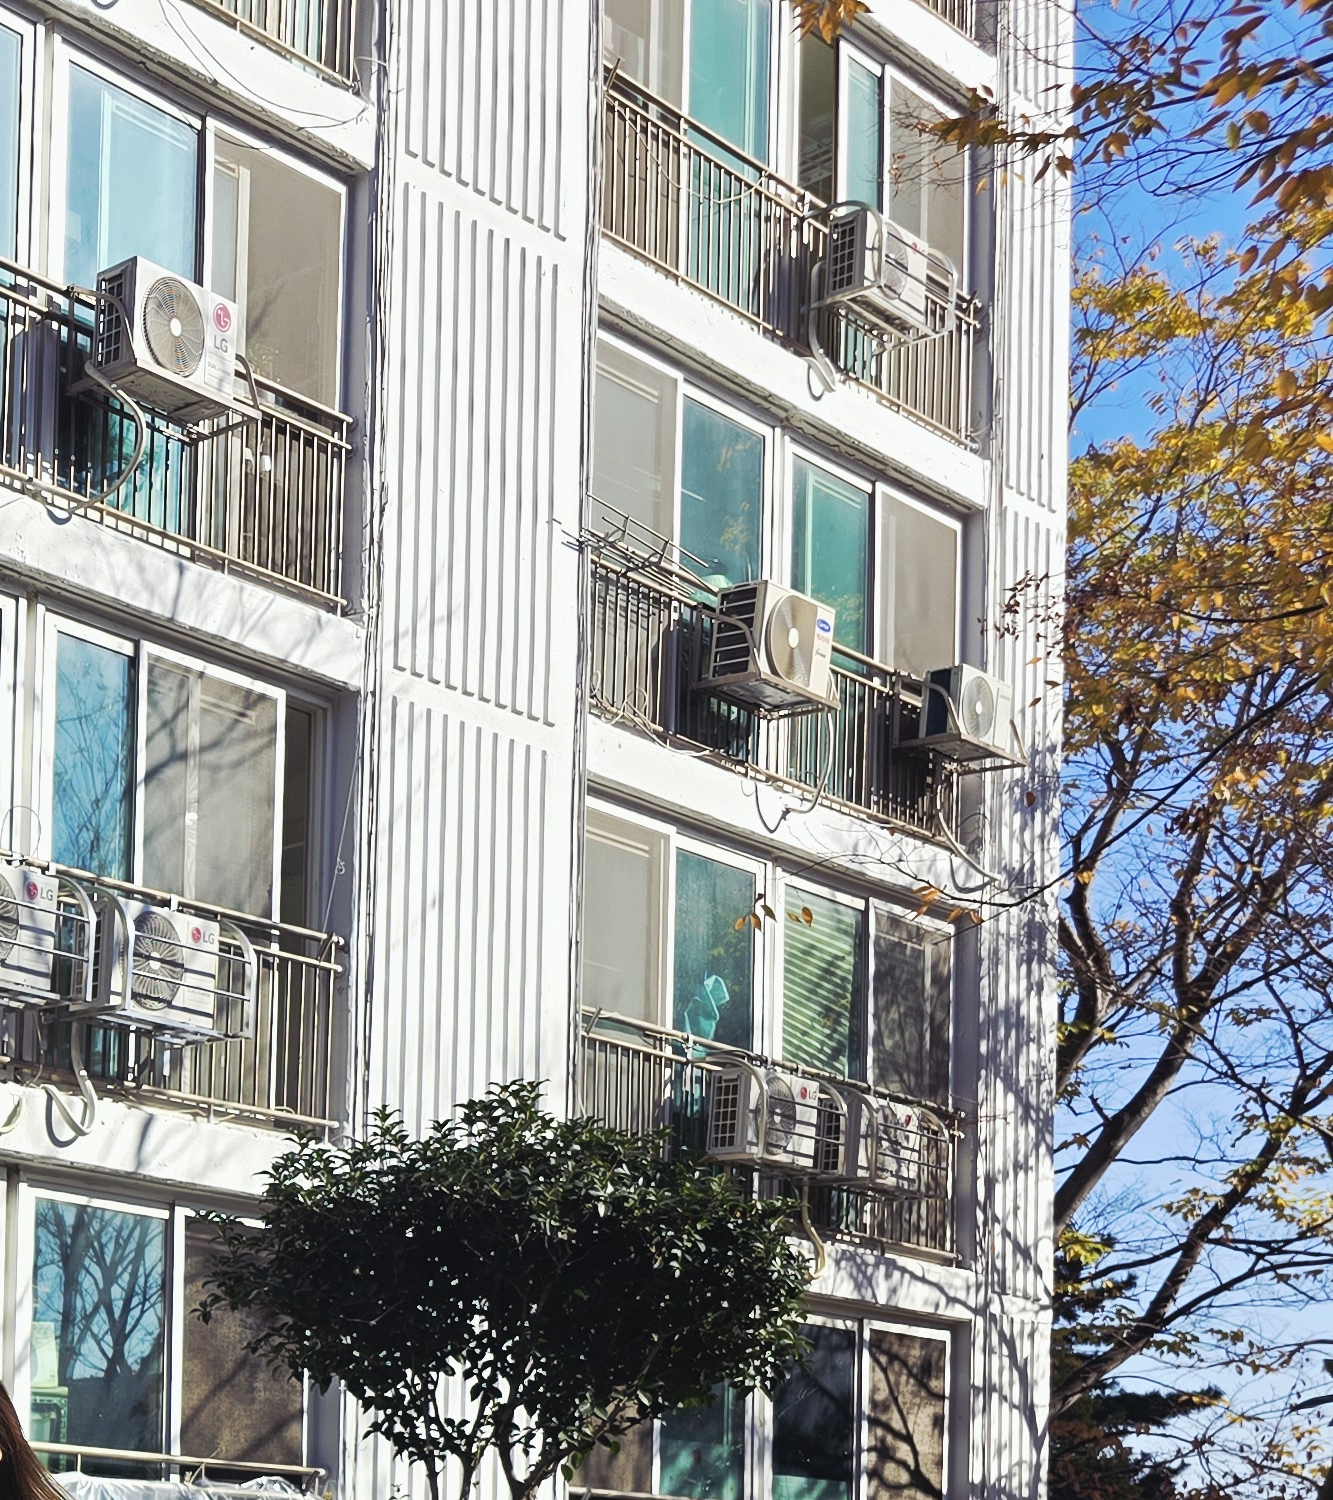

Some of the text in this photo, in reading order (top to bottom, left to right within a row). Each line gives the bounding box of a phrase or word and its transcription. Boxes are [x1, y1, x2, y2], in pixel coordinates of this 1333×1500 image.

[214, 333, 229, 354] LG
[39, 886, 54, 902] LG
[202, 930, 215, 945] LG
